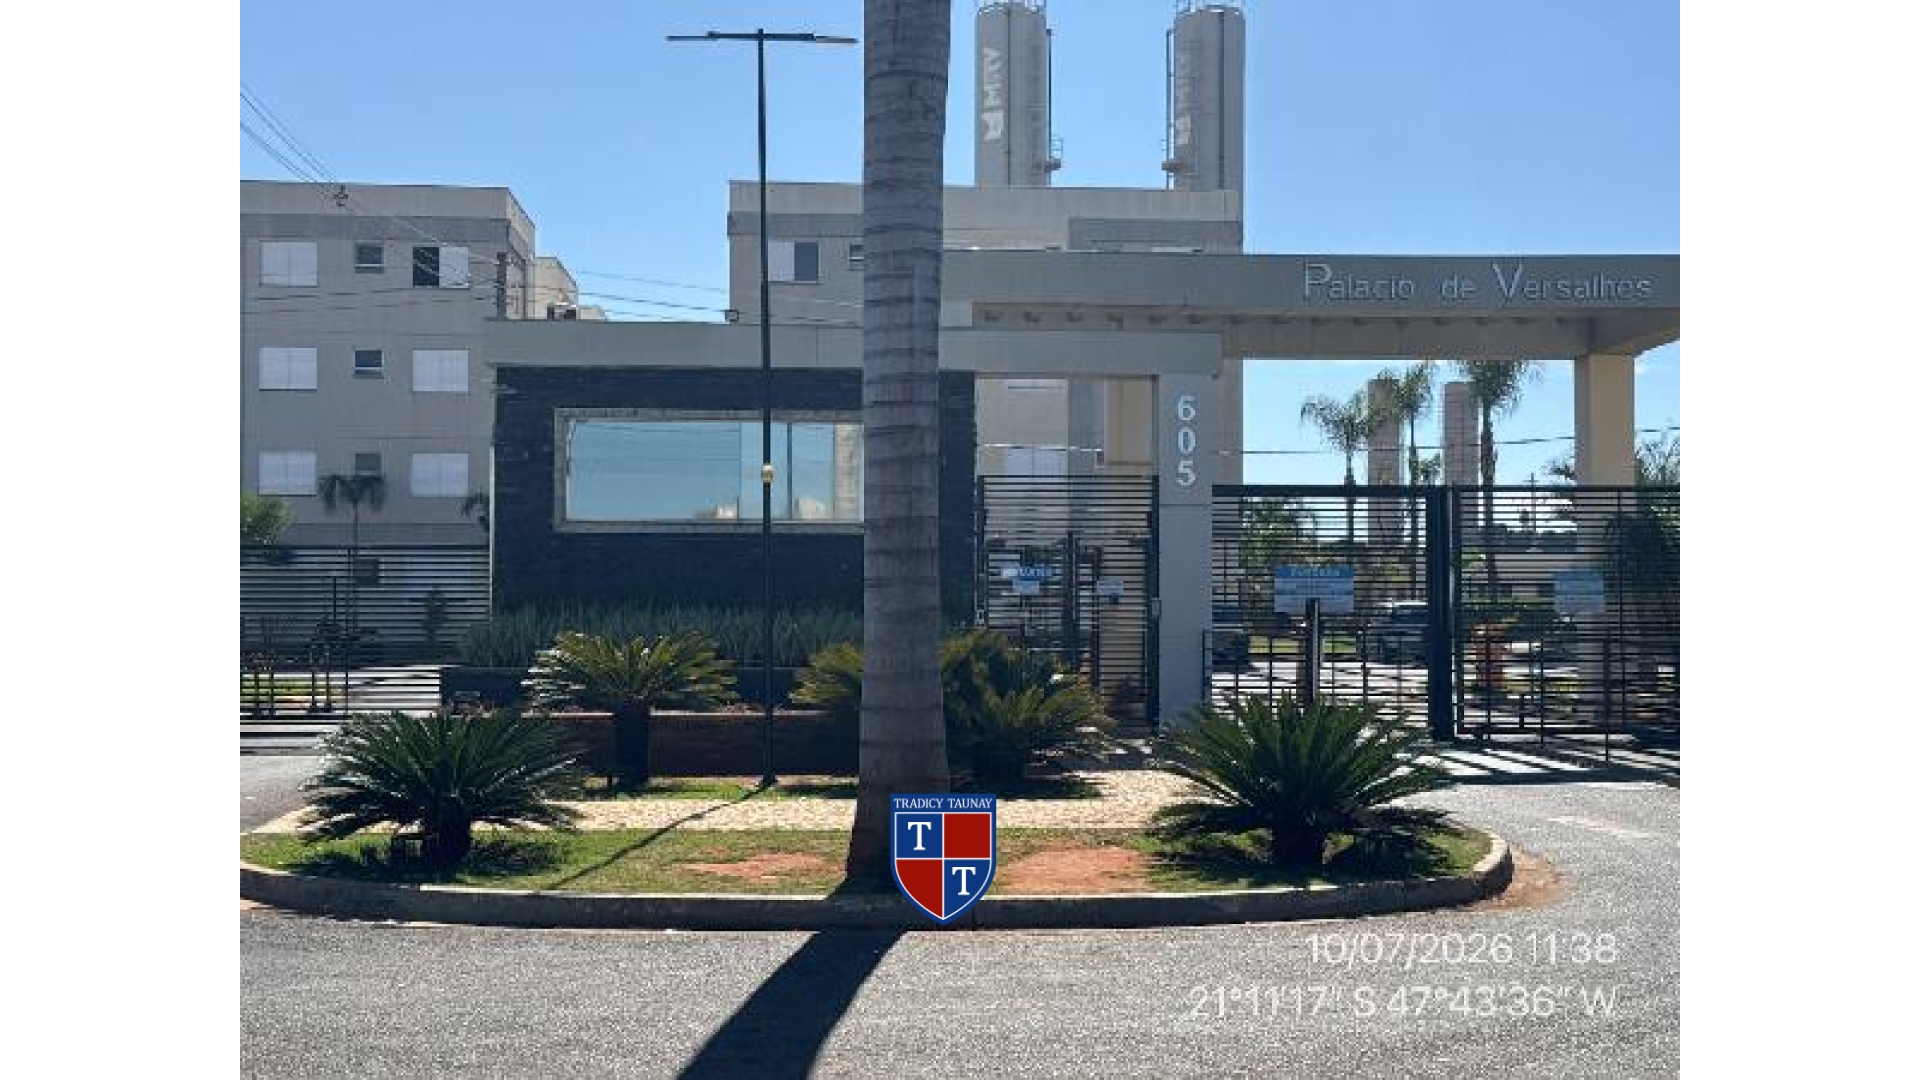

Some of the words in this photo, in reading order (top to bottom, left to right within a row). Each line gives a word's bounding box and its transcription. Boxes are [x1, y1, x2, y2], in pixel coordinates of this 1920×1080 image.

[1442, 275, 1477, 299] de
[1492, 263, 1651, 299] Versalhes
[1177, 395, 1196, 486] 605
